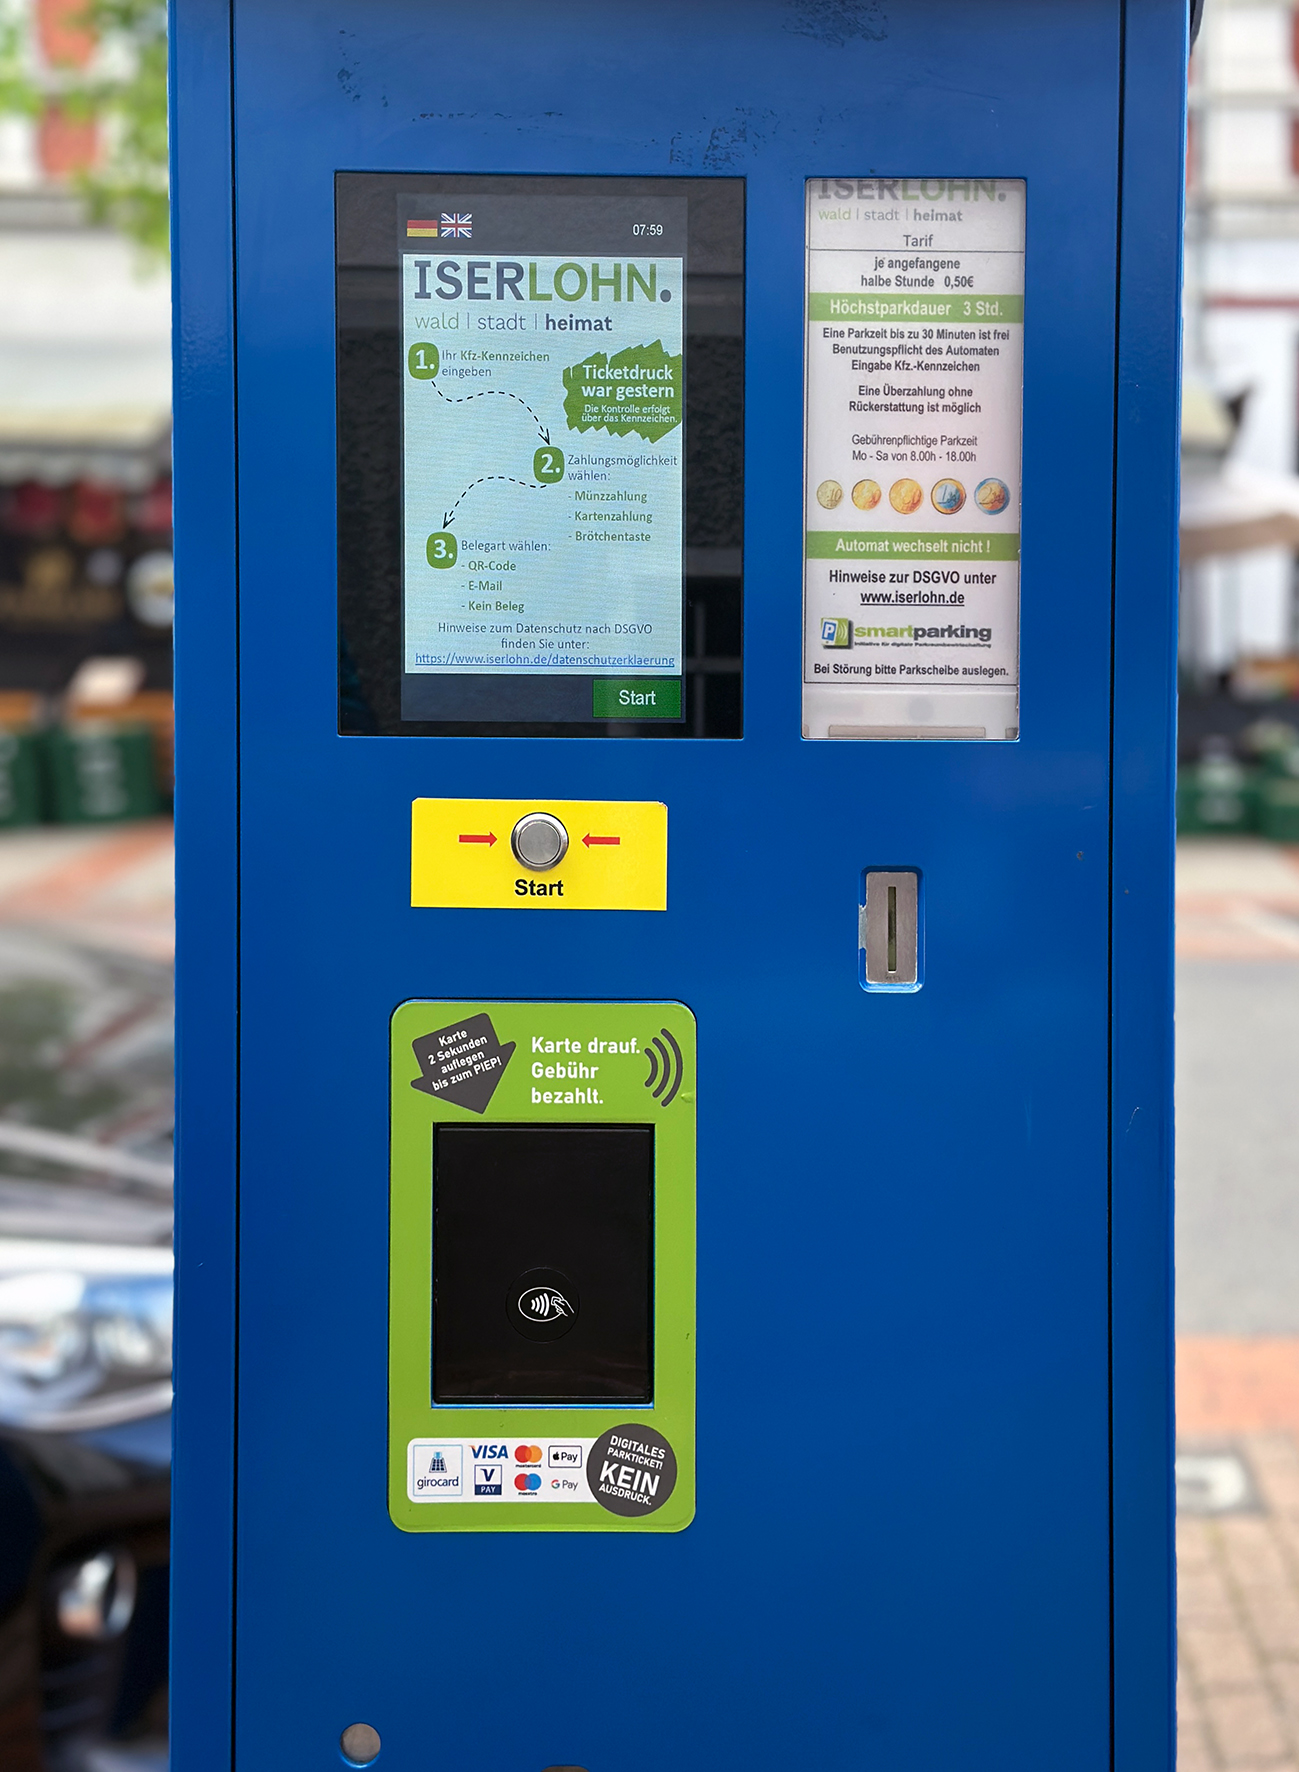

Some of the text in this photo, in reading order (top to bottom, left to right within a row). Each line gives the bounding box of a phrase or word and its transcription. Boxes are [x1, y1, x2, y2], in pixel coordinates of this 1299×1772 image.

[818, 208, 963, 221] wald stadt heimat
[632, 224, 663, 236] 07:59
[903, 234, 934, 247] Tarif
[874, 257, 960, 271] je angefangene
[414, 261, 672, 303] ISERLOHN.
[861, 275, 974, 289] halbe Stunde 0,50€
[830, 300, 1003, 318] Höchstparkdauer 3 Std.
[415, 313, 613, 332] wald stadt heimat
[823, 328, 1010, 340] Eine Parkzeit bis zu 30 Minuten ist frei
[832, 344, 999, 358] Benutzungspflicht des Automaten
[415, 350, 550, 369] 1. Ihr Kfz-Kennzeichen
[852, 360, 980, 373] Eingabe Kfz.-Kennzeichen
[442, 366, 492, 379] eingeben
[583, 364, 673, 380] Ticketdruck
[581, 384, 674, 401] war gestern
[858, 383, 973, 398] Eine Überzahlung ohne
[585, 405, 670, 415] Die Kontrolle erfolgt
[849, 401, 981, 415] Rückerstattung ist möglich
[582, 413, 677, 423] über das Kennzeichen.
[852, 434, 978, 446] Gebührenpflichtige Parkzeit
[852, 451, 867, 461] Mo
[876, 451, 889, 461] Sa
[891, 453, 908, 461] von
[910, 451, 936, 462] 8.00h
[946, 451, 976, 462] 18.00h
[541, 454, 677, 474] 2. Zahlungsmöglichkeit
[568, 469, 611, 482] wählen:
[575, 490, 647, 503] Münzzahlung
[575, 510, 653, 523] Kartenzahlung
[575, 530, 651, 542] Brötchentaste
[433, 540, 551, 559] 3. Belegart wählen:
[836, 539, 991, 553] Automat wechselt nicht !
[468, 561, 517, 573] QR-Code
[829, 570, 997, 585] Hinweise zur DSGVO unter
[468, 580, 503, 591] E-Mail
[860, 591, 965, 605] www.iserlohn.de
[468, 601, 492, 612] Kein
[495, 601, 525, 614] Beleg
[438, 622, 653, 635] Hinweise zum Datenschutz nach DSGVO
[854, 625, 992, 641] smartparking
[501, 638, 590, 650] finden Sie unter:
[415, 652, 675, 667] https://www.iserlohn.de/datenschutzerklaerung
[814, 664, 1009, 677] Bei Störung bitte Parkscheibe auslegen.
[618, 690, 656, 706] Start
[515, 879, 564, 897] Start
[438, 1028, 468, 1047] Karte
[428, 1034, 488, 1066] 2 Sekunden
[532, 1036, 640, 1054] Karte drauf.
[440, 1050, 485, 1074] auflegen
[432, 1056, 502, 1092] bis zum PIEP!
[532, 1062, 599, 1078] Gebühr
[532, 1088, 603, 1104] bezahlt.
[469, 1445, 508, 1459] VISA
[610, 1435, 666, 1460] DIGITALES
[561, 1452, 578, 1462] Pay
[606, 1448, 663, 1470] PARKTICKET!
[417, 1476, 459, 1490] girocard
[598, 1460, 660, 1496] KEIN
[562, 1480, 578, 1491] Pay
[598, 1485, 652, 1506] AUSDRUCK.
